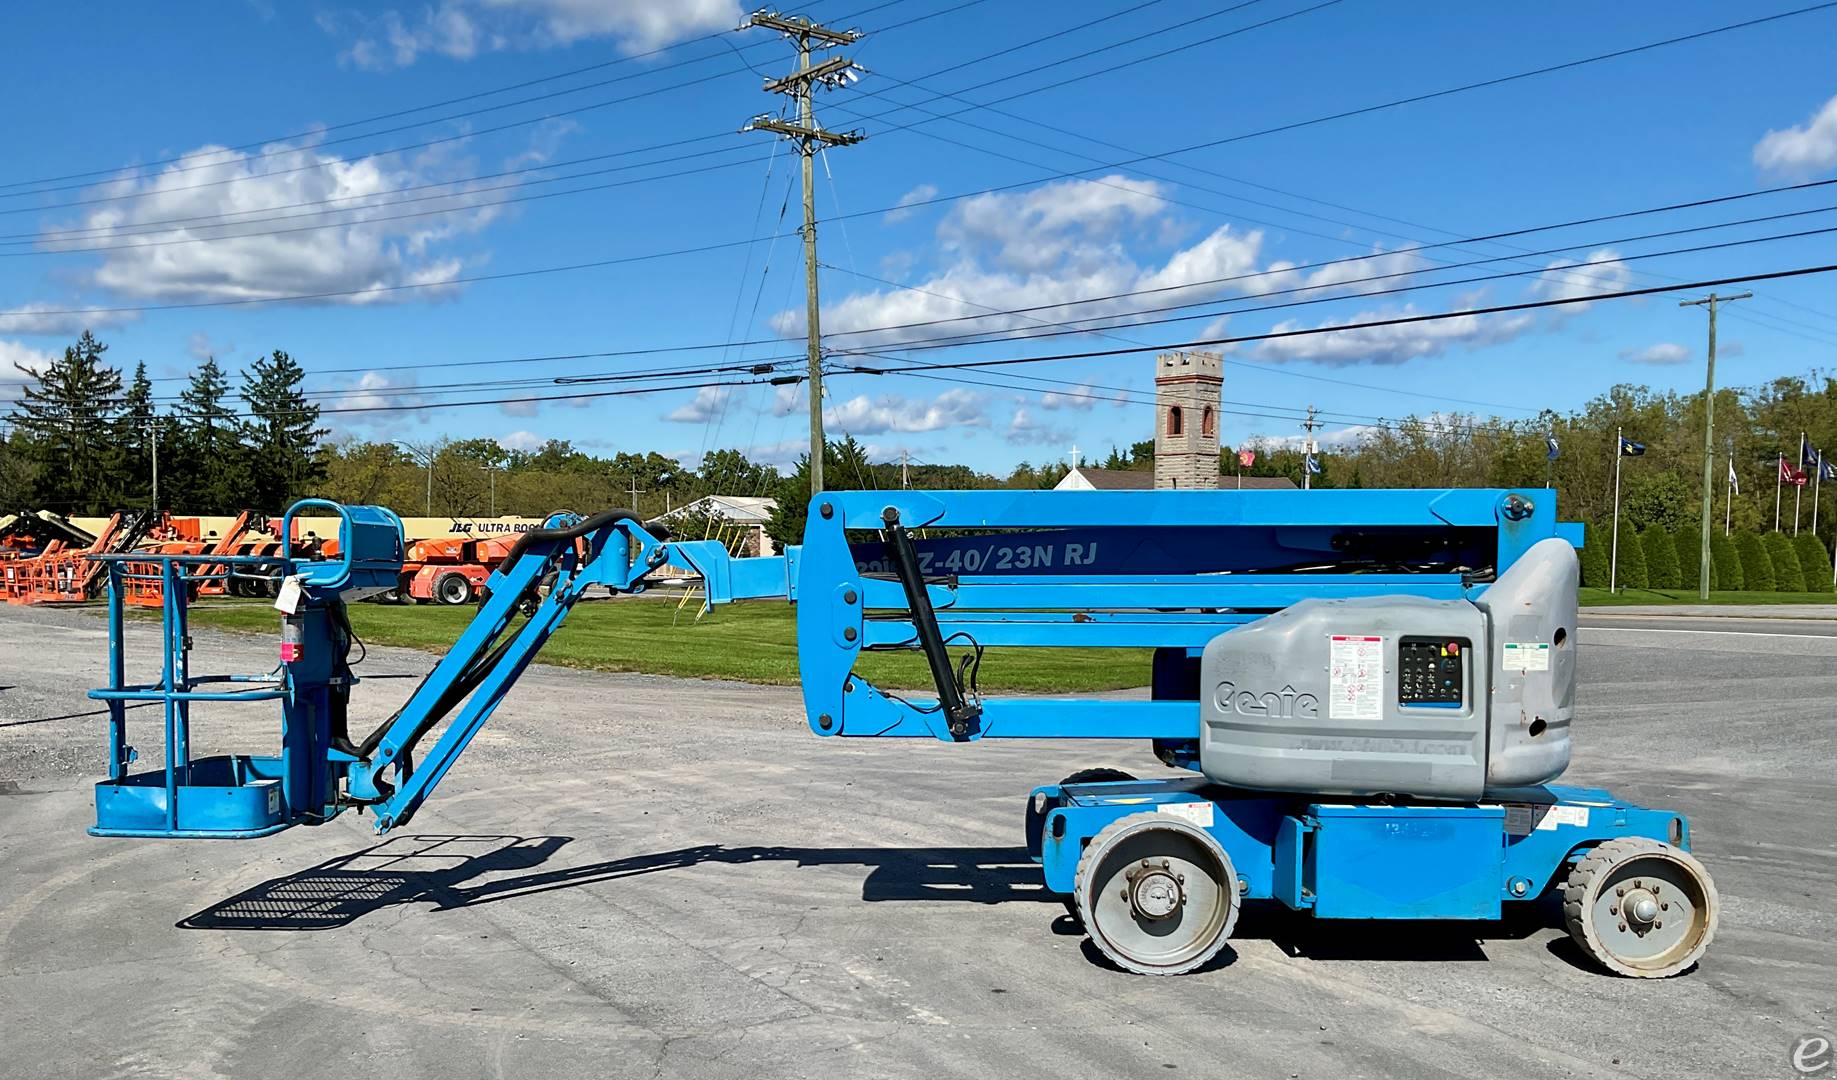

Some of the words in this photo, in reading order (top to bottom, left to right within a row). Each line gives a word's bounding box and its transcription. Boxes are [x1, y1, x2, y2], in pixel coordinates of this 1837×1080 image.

[449, 523, 472, 533] JLG
[478, 523, 511, 533] ULTRA
[918, 545, 1053, 574] Z-40/23N
[1064, 542, 1097, 565] RJ
[1213, 680, 1319, 719] Genie
